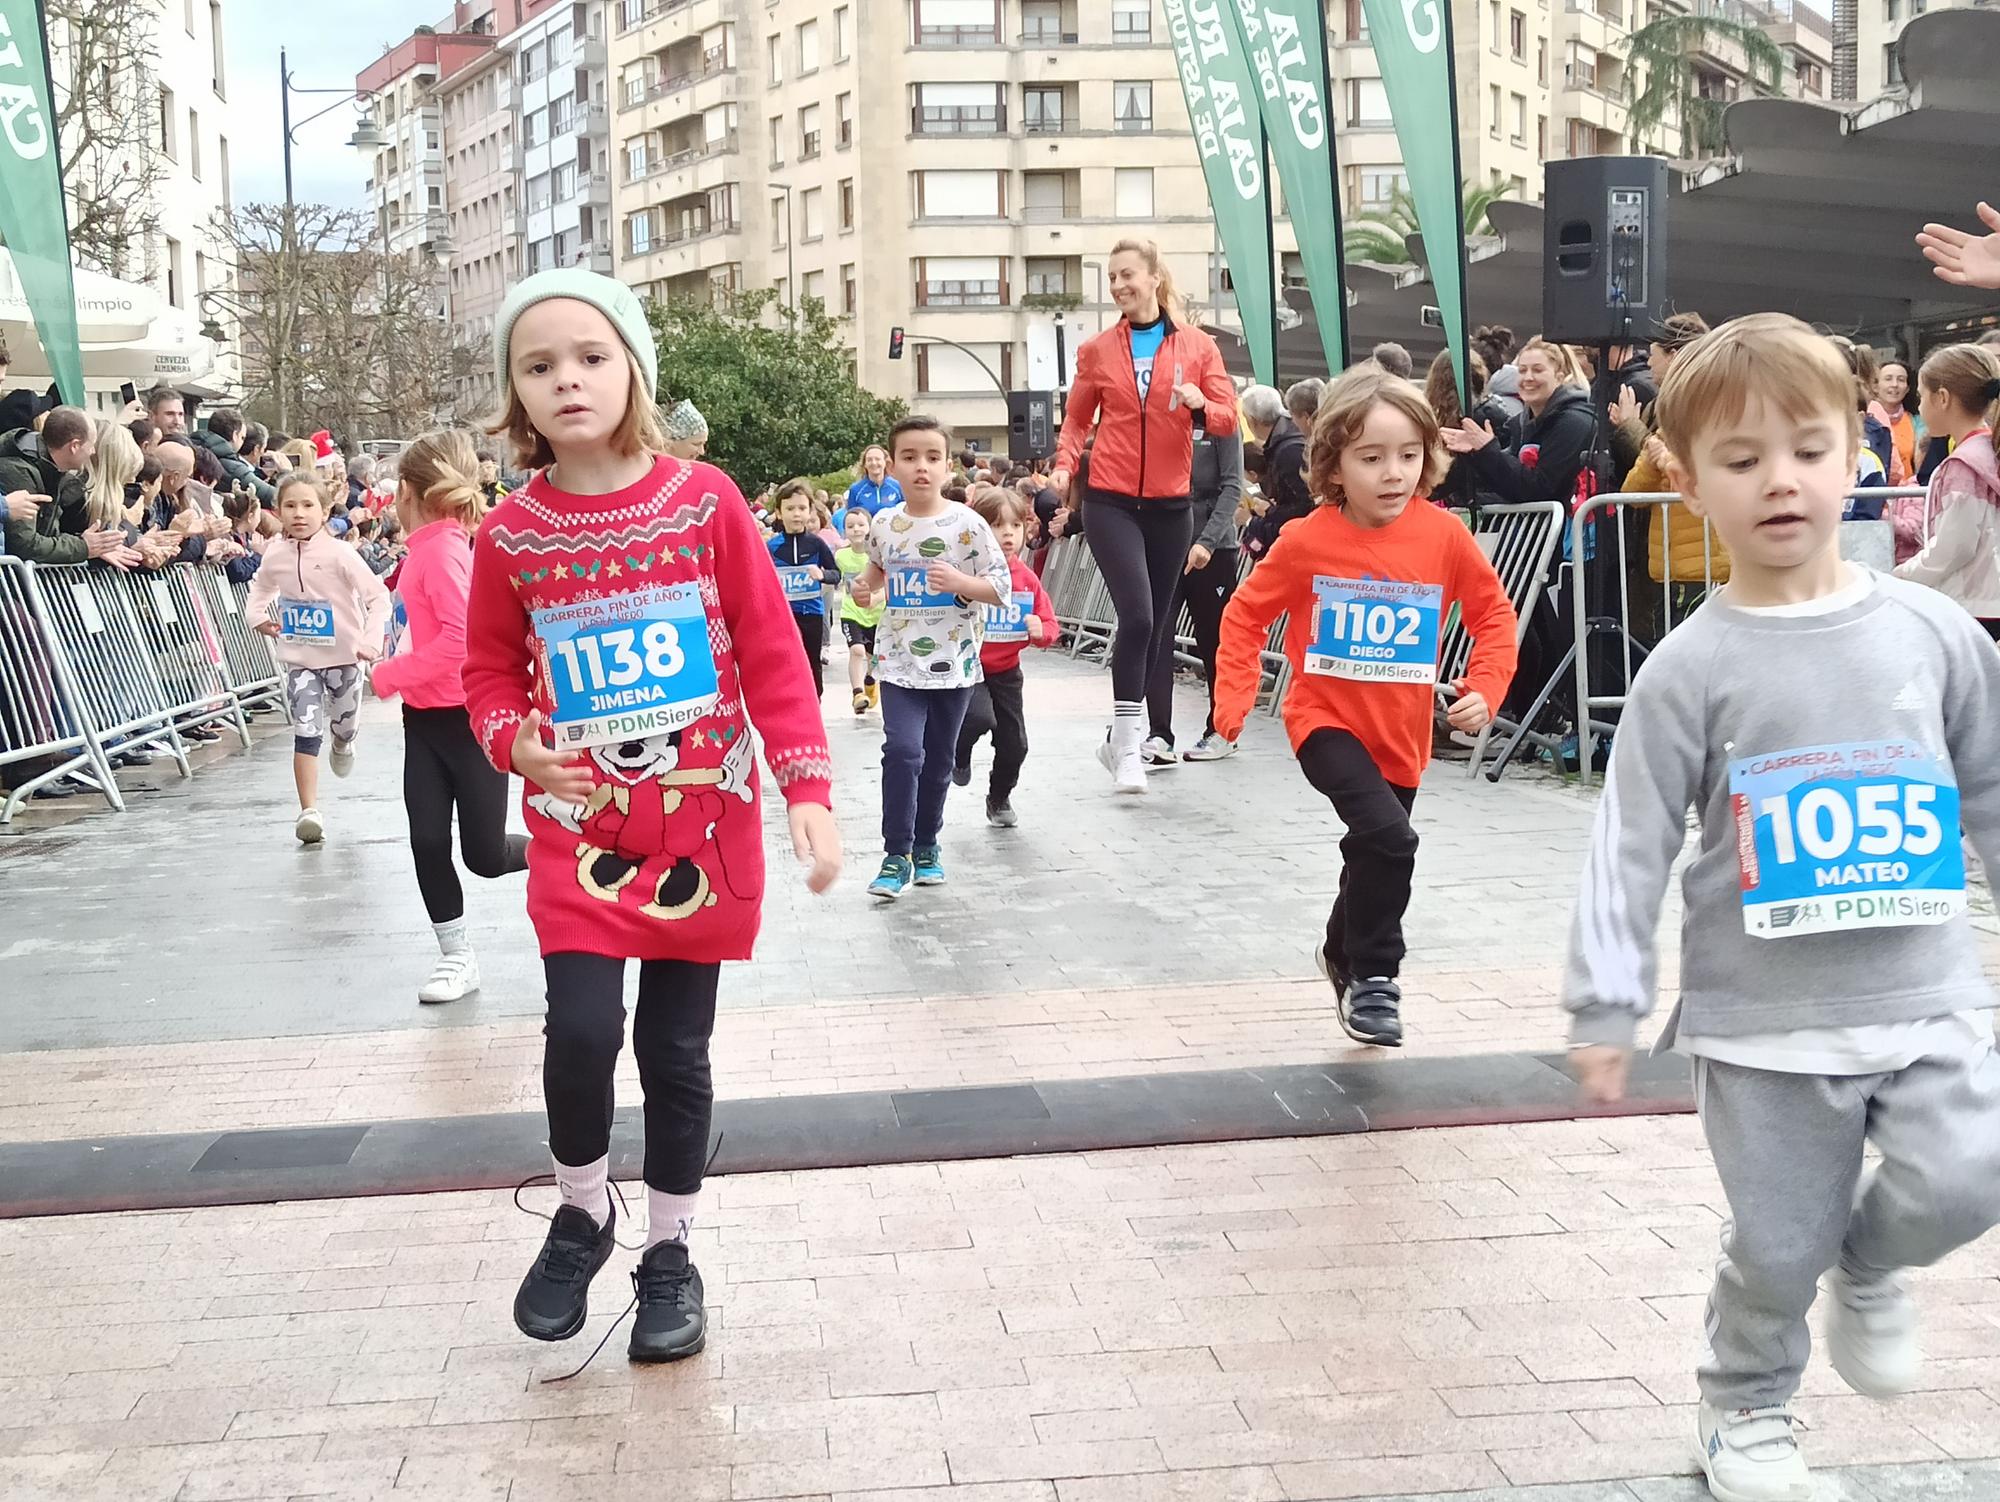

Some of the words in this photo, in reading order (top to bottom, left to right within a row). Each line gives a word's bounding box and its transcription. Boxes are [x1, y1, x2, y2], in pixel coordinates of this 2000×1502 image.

[543, 605, 604, 624] CARRERA
[608, 600, 630, 614] FIN
[633, 593, 651, 608] DE
[654, 588, 683, 604] AÑO
[904, 597, 922, 606] TEO
[286, 608, 327, 628] 1140
[1331, 601, 1421, 645] 1102
[557, 621, 685, 693] 1138
[1349, 645, 1396, 659] DIEGO
[1352, 663, 1423, 678] PDMSiero
[590, 684, 667, 712] JIMENA
[607, 705, 703, 735] PDMSiero
[1751, 751, 1845, 775] CARRERA
[1760, 783, 1943, 865] 1055
[1814, 861, 1909, 887] MATEO
[1835, 896, 1950, 921] PDMSiero
